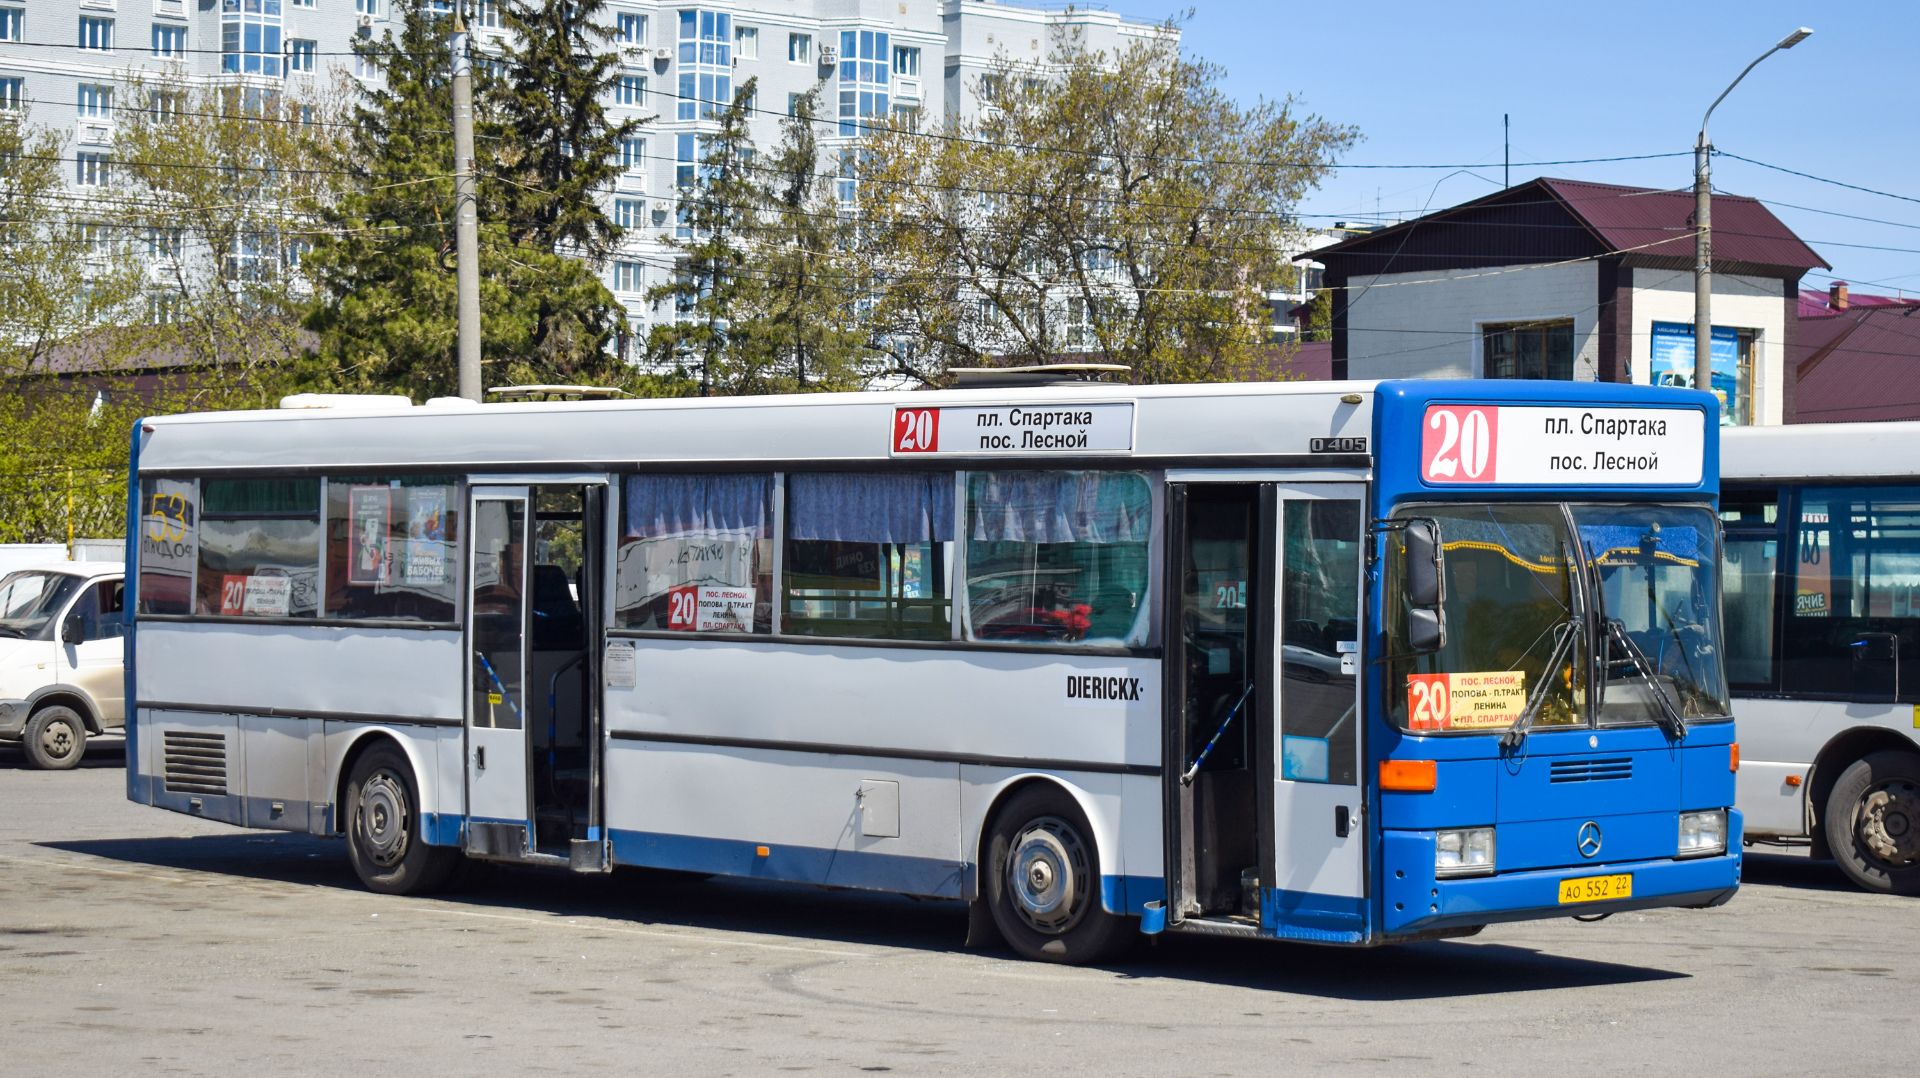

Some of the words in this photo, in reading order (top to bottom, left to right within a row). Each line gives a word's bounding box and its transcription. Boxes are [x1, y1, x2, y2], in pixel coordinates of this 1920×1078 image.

[900, 410, 933, 450] 20
[977, 413, 1003, 427] пл.
[1009, 408, 1093, 430] Спартака
[1545, 417, 1574, 434] пл.
[1580, 412, 1667, 441] Спартака
[980, 436, 1015, 449] пос.
[1021, 430, 1088, 449] Лесной
[1328, 438, 1366, 451] 405
[1428, 409, 1490, 479] 20
[1550, 455, 1587, 470] пос.
[1592, 451, 1658, 470] Лесной
[149, 492, 186, 542] 53
[223, 581, 243, 609] 20
[698, 600, 723, 608] ПОПОВА
[1216, 586, 1236, 608] 20
[671, 592, 695, 625] 20
[1461, 678, 1482, 686] ПОС.
[1412, 681, 1447, 721] 20
[1451, 689, 1488, 698] ПОПОВА
[1474, 702, 1507, 711] ЛЕНИНА
[1477, 714, 1519, 723] СПАРТАКА
[1565, 886, 1581, 899] АО
[1586, 879, 1609, 898] 552
[1615, 877, 1627, 890] 22
